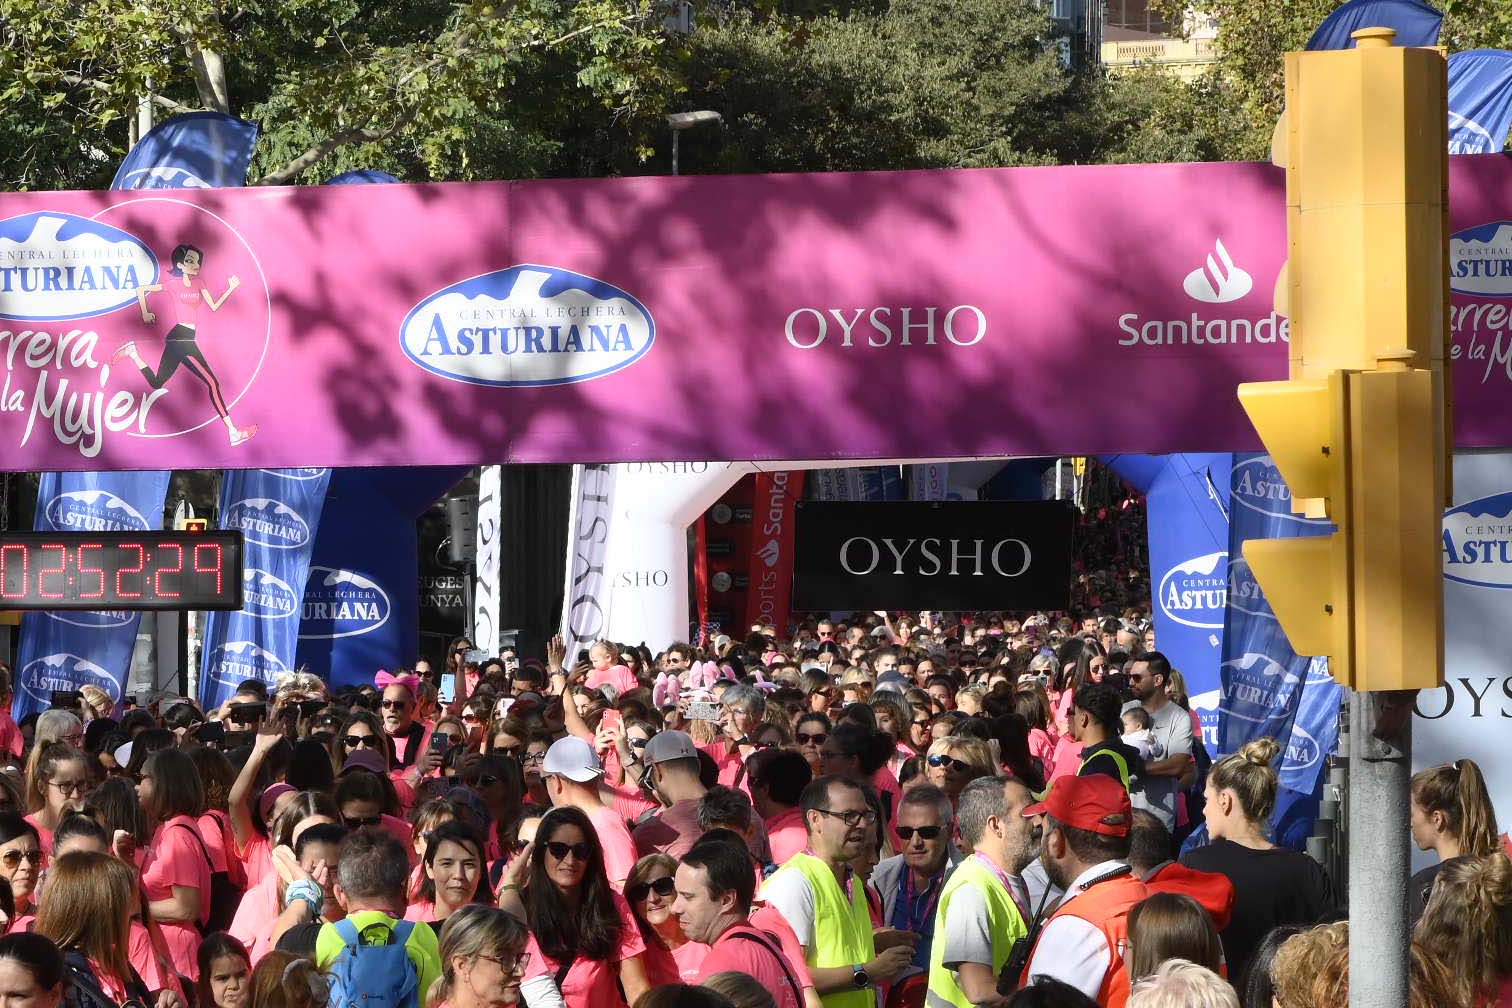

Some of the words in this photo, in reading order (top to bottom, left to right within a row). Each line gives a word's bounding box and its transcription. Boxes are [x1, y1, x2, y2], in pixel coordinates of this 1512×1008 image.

[62, 247, 135, 260] LECHERA
[459, 307, 538, 320] CENTRAL
[545, 304, 627, 318] LECHERA
[784, 304, 988, 349] OYSHO
[420, 312, 635, 357] ASTURIANA
[1117, 312, 1291, 346] Santande
[1468, 333, 1486, 360] la
[0, 371, 25, 413] la
[19, 363, 169, 458] Mujer
[228, 510, 303, 543] ASTURIANA
[0, 542, 224, 599] 02:52:29
[839, 536, 1033, 578] OYSHO
[1182, 578, 1226, 588] CENTRA
[300, 601, 381, 621] URIANA
